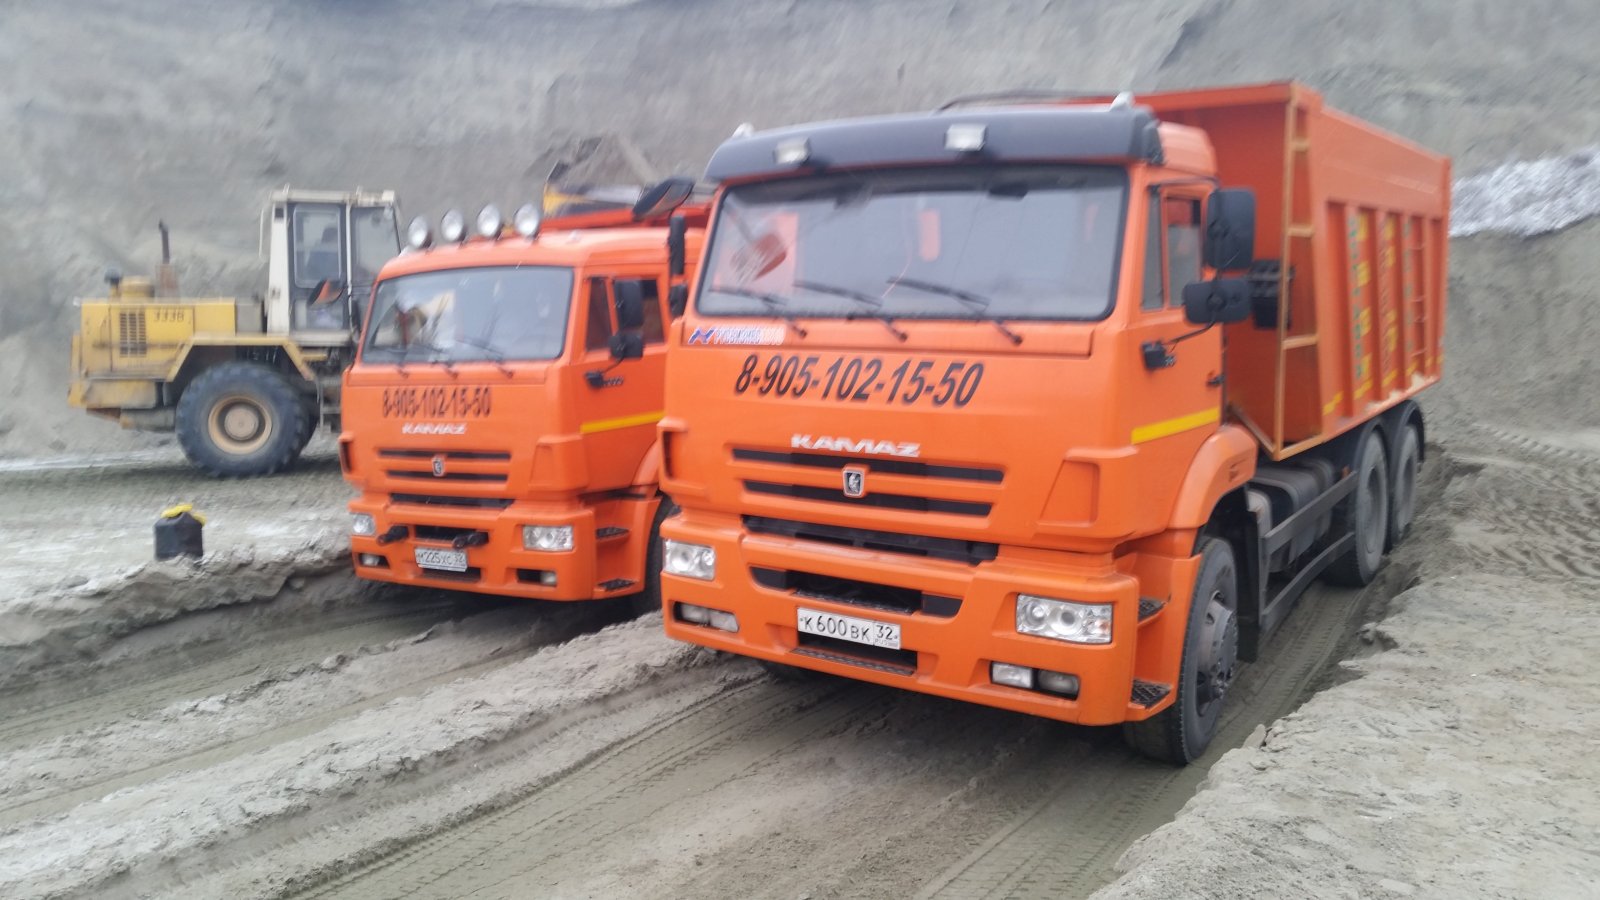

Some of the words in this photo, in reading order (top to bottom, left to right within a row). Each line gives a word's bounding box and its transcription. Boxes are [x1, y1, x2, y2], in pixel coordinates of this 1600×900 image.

[735, 353, 985, 409] 8-905-102-15-50
[383, 386, 491, 419] 8-905-102-15-50
[402, 422, 467, 435] KAMAZ
[791, 434, 921, 458] KAMAZ
